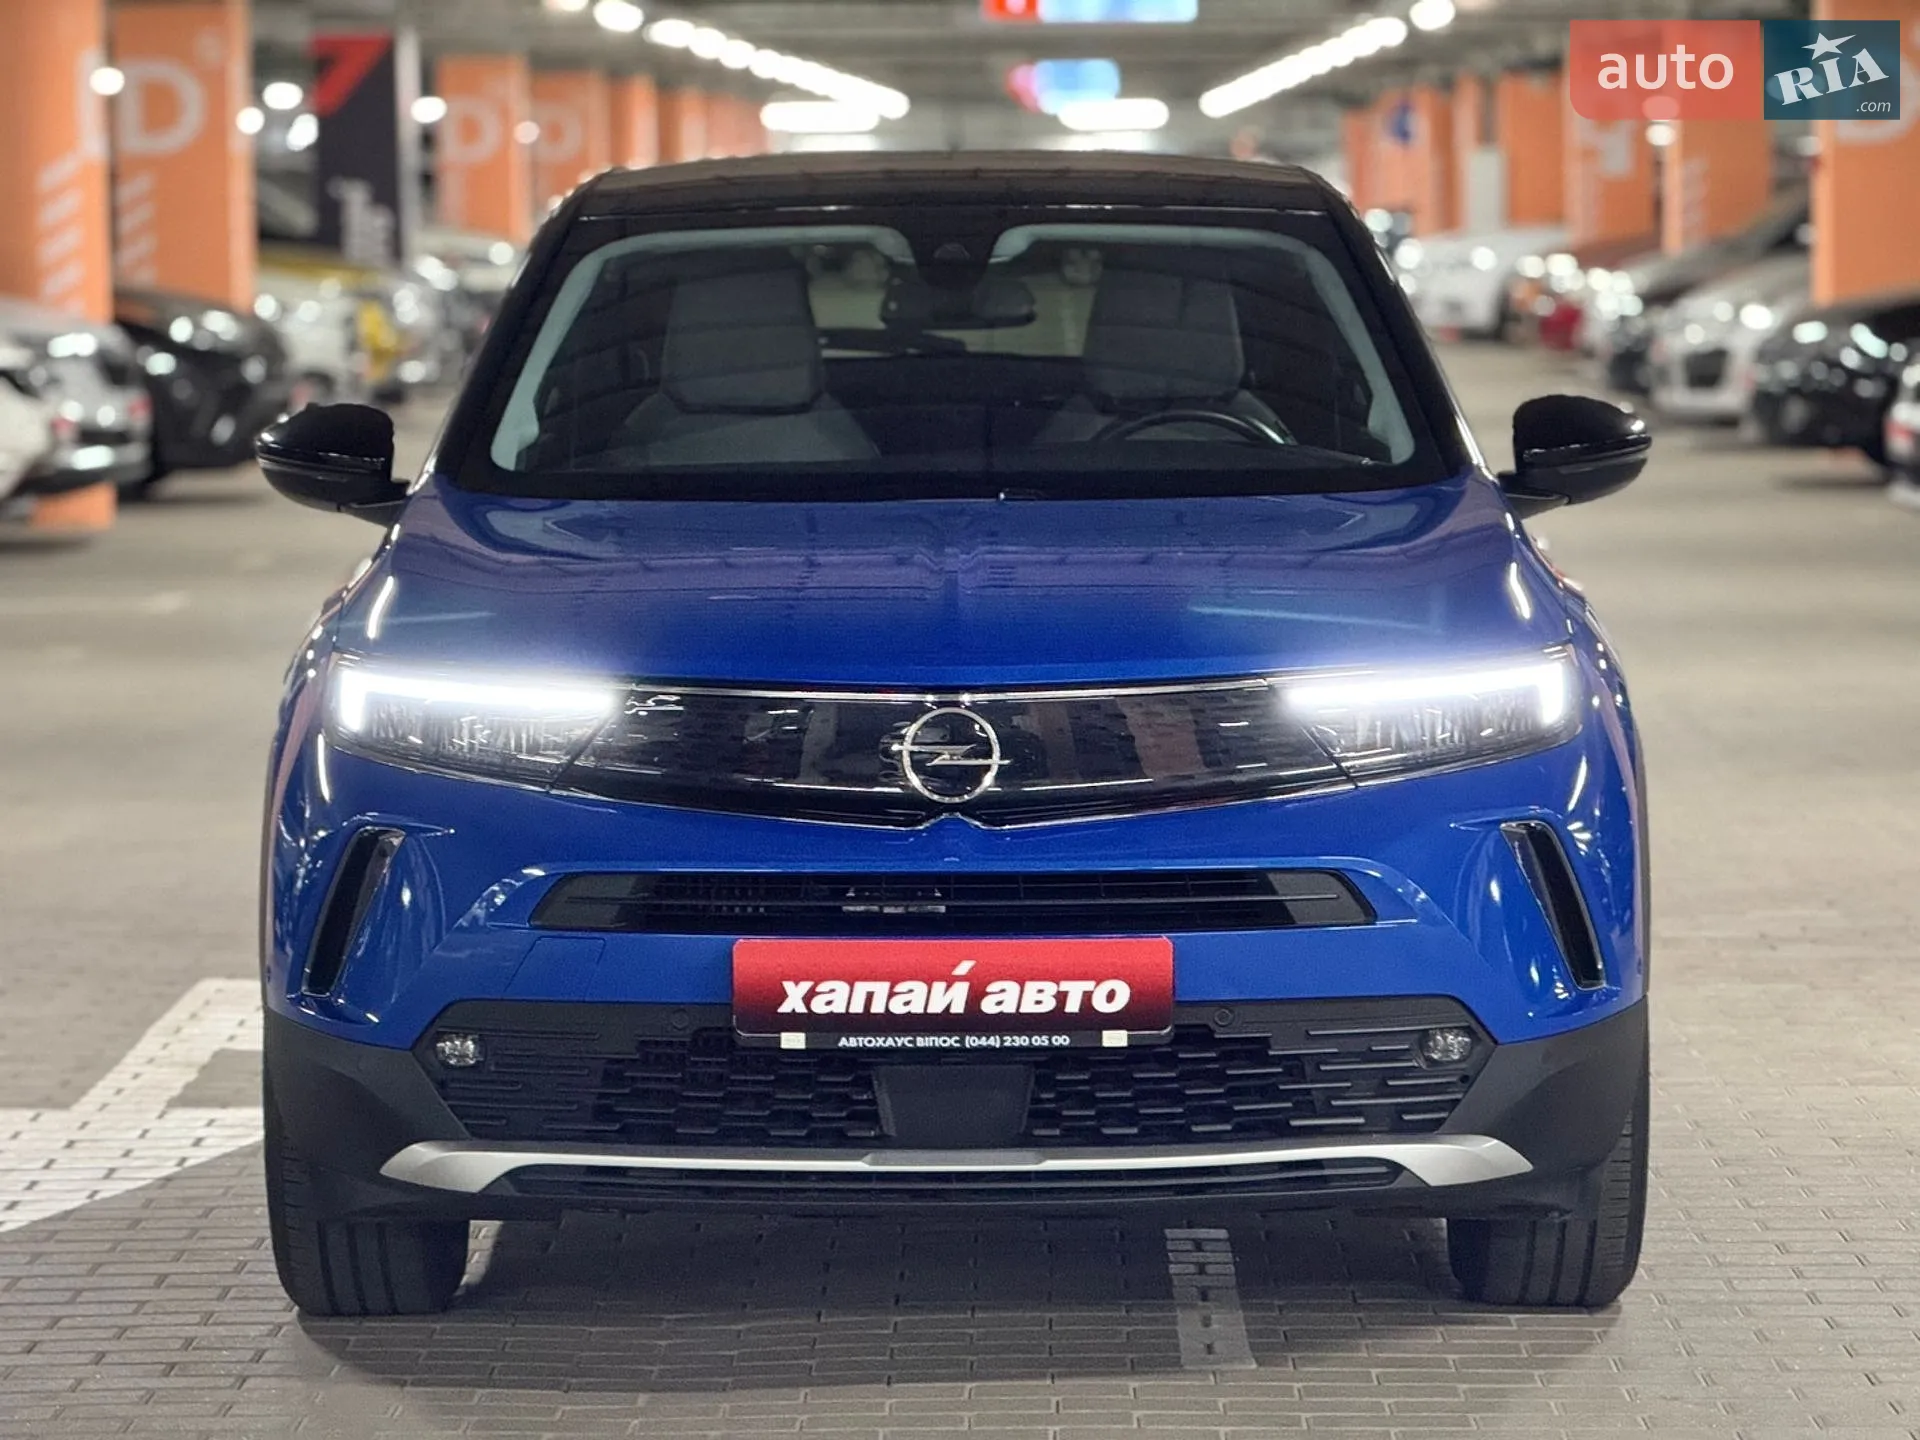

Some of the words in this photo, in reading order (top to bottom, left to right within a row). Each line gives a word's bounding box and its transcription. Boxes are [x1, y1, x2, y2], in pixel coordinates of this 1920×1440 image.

[980, 979, 1131, 1015] авто
[838, 1036, 912, 1048] АВТОХАУС
[965, 1035, 1001, 1048] (044)
[1004, 1035, 1029, 1047] 230
[1031, 1035, 1049, 1046] 05
[1052, 1035, 1071, 1046] 00
